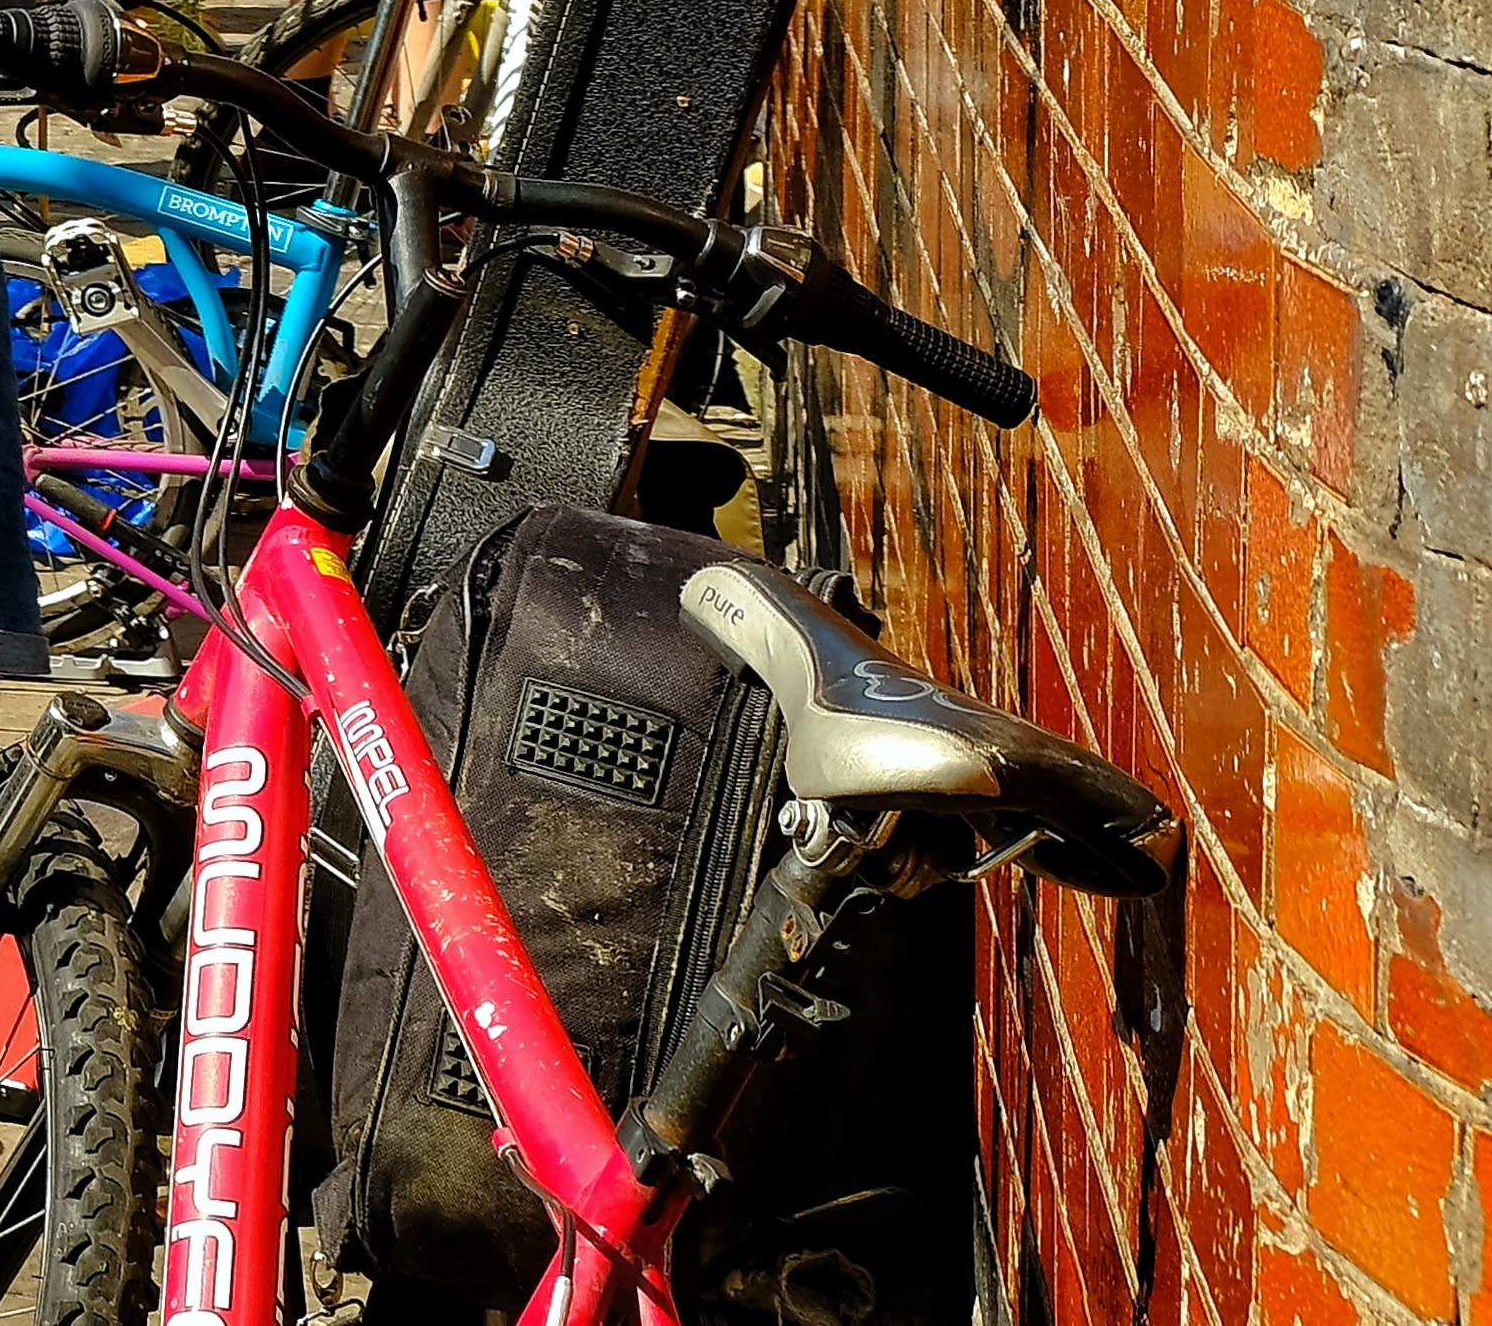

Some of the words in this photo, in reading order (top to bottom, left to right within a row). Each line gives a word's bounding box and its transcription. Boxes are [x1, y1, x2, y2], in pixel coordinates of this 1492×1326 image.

[168, 194, 283, 242] BROMPTN
[698, 585, 746, 626] pure
[340, 699, 410, 827] IMPEL
[161, 744, 270, 1326] MUDDYF
